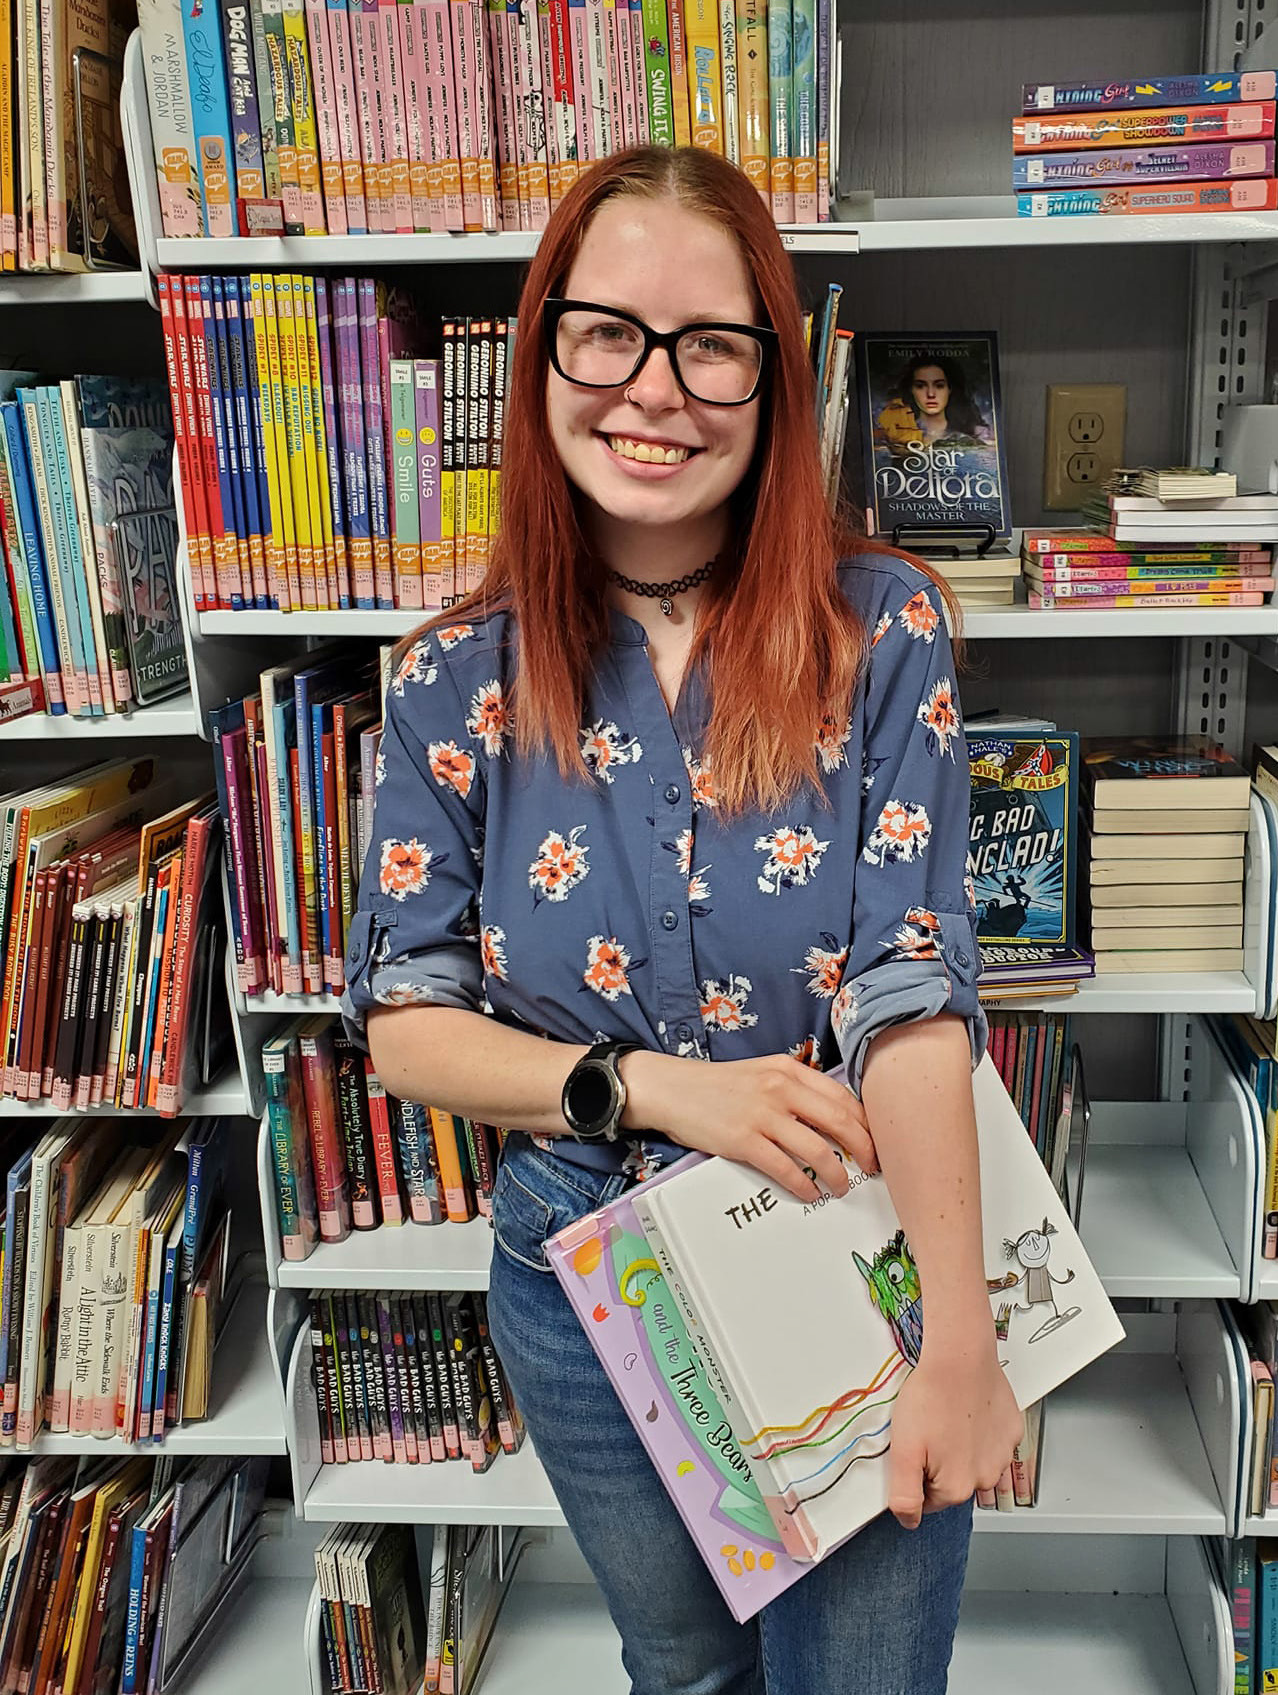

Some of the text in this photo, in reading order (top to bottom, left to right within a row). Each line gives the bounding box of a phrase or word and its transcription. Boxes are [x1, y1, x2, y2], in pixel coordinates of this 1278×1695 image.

[229, 6, 250, 74] DOG MAN
[672, 12, 683, 50] AMERICAN
[151, 54, 169, 118] & JORDAN
[165, 33, 188, 134] MARSHMALLOW
[190, 30, 217, 112] El Deafo
[269, 36, 285, 118] HAZARDOUS TALES
[288, 38, 303, 92] HAZARDOUS
[650, 69, 666, 117] SWING
[1120, 115, 1188, 130] SUPERPOWER
[1123, 127, 1185, 140] SHOWDOWN
[1194, 159, 1226, 169] DIXON
[165, 333, 178, 389] STAR WARS
[179, 333, 191, 389] STAR WARS
[197, 335, 209, 390] STAR WARS
[258, 333, 271, 422] SPIDEY WEEKDAYS
[269, 334, 282, 423] SPIDEY BLACKOUT!
[298, 334, 306, 360] SPIDEY
[302, 385, 310, 417] MISSING
[287, 335, 301, 451] SPIDEY REPUTATION
[444, 342, 453, 440] GERONIMO STILTON
[456, 342, 465, 437] GERONIMO STILTON
[469, 344, 479, 439] GERONIMO STILTON
[479, 340, 490, 438] GERONIMO STILTON
[493, 342, 505, 440] GERONIMO STILTON
[398, 455, 415, 503] Smile
[421, 454, 437, 498] Guts
[903, 440, 965, 473] Star
[40, 400, 70, 573] TONGUES TAILS Theresa Greenaway
[51, 400, 80, 562] TEETH TUSKS Theresa Greenaway
[875, 467, 1000, 507] Deltora
[916, 512, 966, 520] MASTER
[26, 532, 48, 618] LEAVING HOME
[97, 551, 108, 588] PACKS
[1020, 774, 1061, 790] TALES
[991, 804, 1035, 837] BAD
[225, 834, 234, 871] Armstrong
[146, 877, 155, 909] HAMILTON
[320, 891, 329, 911] Dark
[342, 883, 352, 915] DEWEY
[179, 894, 194, 942] CURIOSITY
[5, 913, 18, 978] THE BUSY BODY
[312, 1110, 330, 1201] REBEL LIBRARY EVER
[341, 1096, 354, 1172] Part-Time Indian
[350, 1088, 366, 1179] Absolutely True Diary
[377, 1133, 393, 1179] FEVER
[275, 1132, 294, 1213] LIBRARY EVER
[411, 1152, 419, 1167] AND
[724, 1187, 779, 1230] THE
[803, 1205, 811, 1217] A
[25, 1164, 44, 1328] The Children's Book Virtues Edited William
[166, 1258, 174, 1274] COLE
[182, 1234, 196, 1275] PLUM
[59, 1245, 77, 1361] Silverstein Runny Babbit
[75, 1233, 97, 1383] Silverstein A Light in the Attic
[100, 1231, 122, 1394] Silverstein Where the Sidewalk Ends
[659, 1248, 732, 1404] THE COLOR MONSTER
[316, 1366, 327, 1411] BAD GUYS
[328, 1369, 339, 1413] BAD GUYS
[342, 1364, 353, 1409] BAD GUYS
[353, 1364, 364, 1408] BAD GUYS
[365, 1362, 376, 1406] BAD GUYS
[374, 1367, 386, 1411] BAD GUYS
[387, 1367, 398, 1412] BAD GUYS
[399, 1368, 411, 1413] BAD GUYS
[410, 1368, 422, 1413] BAD GUYS
[423, 1364, 436, 1409] BAD GUYS
[438, 1364, 451, 1409] BAD GUYS
[460, 1374, 473, 1419] BAD GUYS
[486, 1358, 502, 1403] BAD GUYS
[652, 1303, 754, 1484] and the Three Bears
[99, 1578, 109, 1598] Oregon
[125, 1588, 140, 1676] HOLDING REINS
